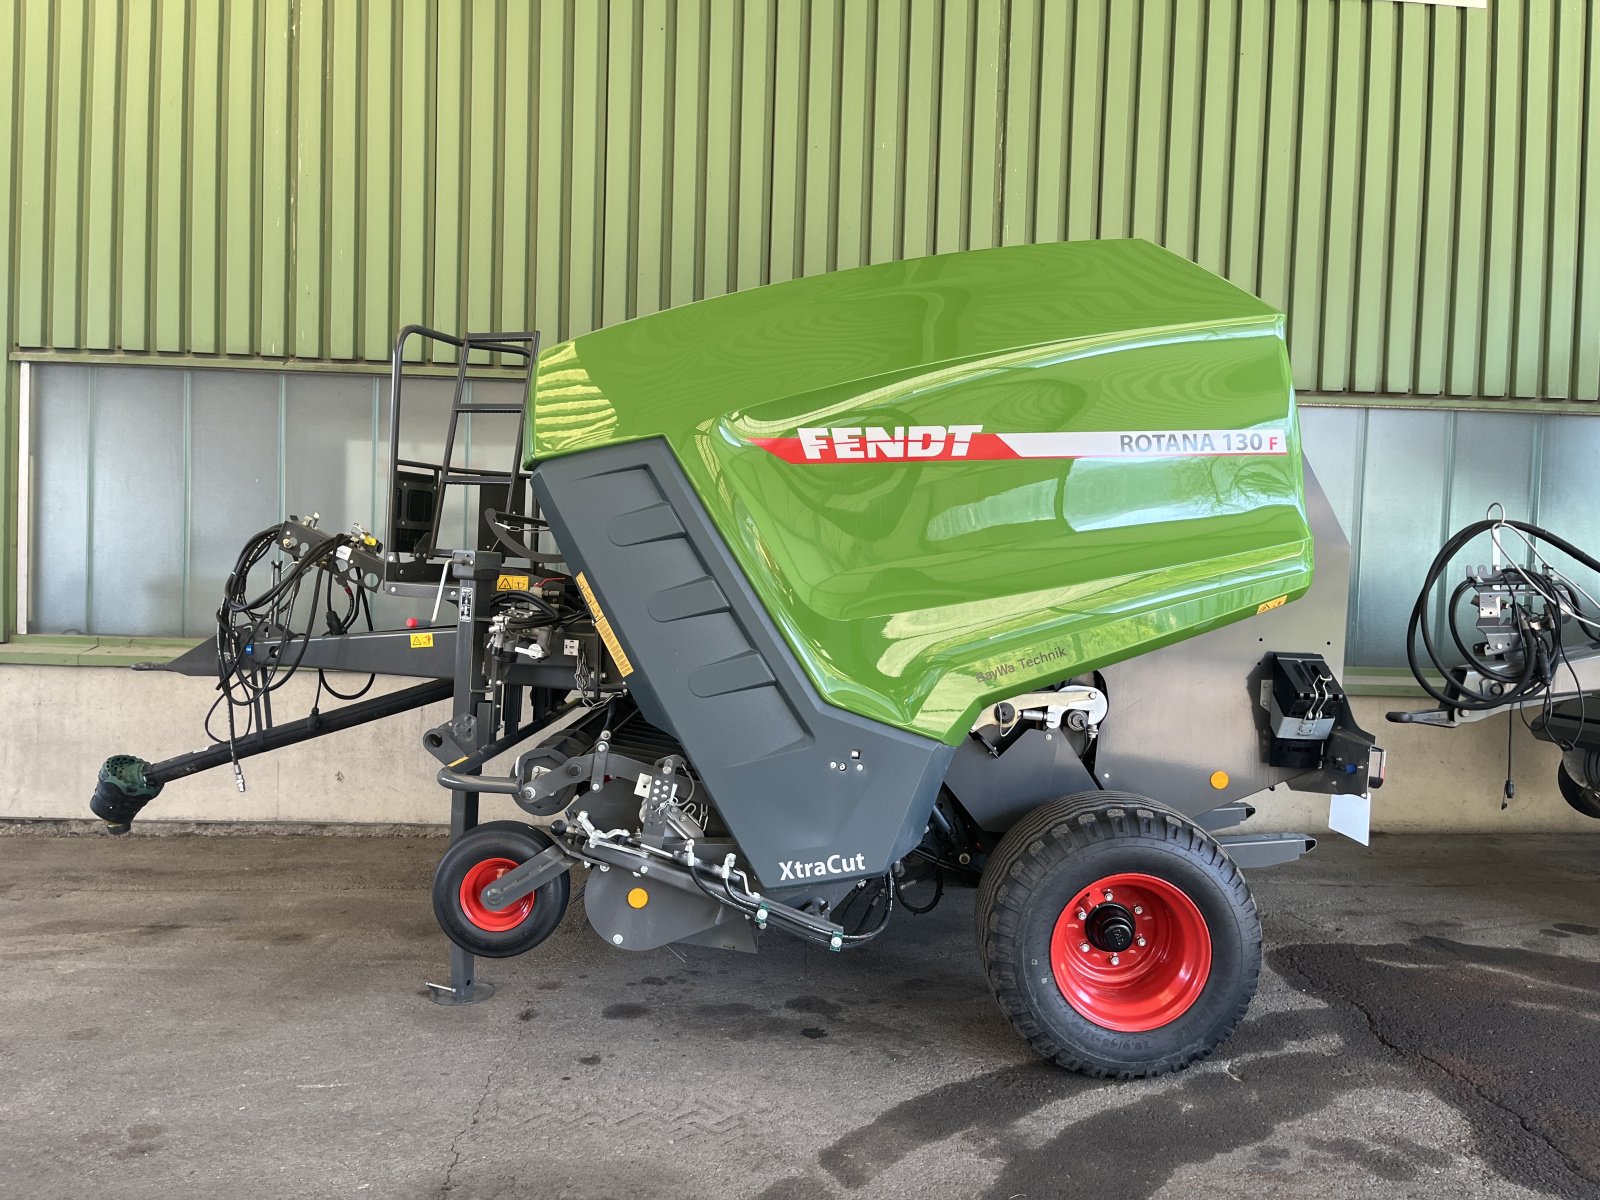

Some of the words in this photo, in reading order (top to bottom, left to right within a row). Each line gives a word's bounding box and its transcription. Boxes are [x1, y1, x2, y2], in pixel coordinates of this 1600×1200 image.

[797, 425, 983, 459] FENDT
[1120, 434, 1215, 452] ROTANA
[1223, 433, 1263, 451] 130
[1269, 437, 1278, 450] F
[976, 663, 1015, 683] BayWa
[1017, 646, 1067, 669] Technik
[779, 853, 866, 880] XtraCut
